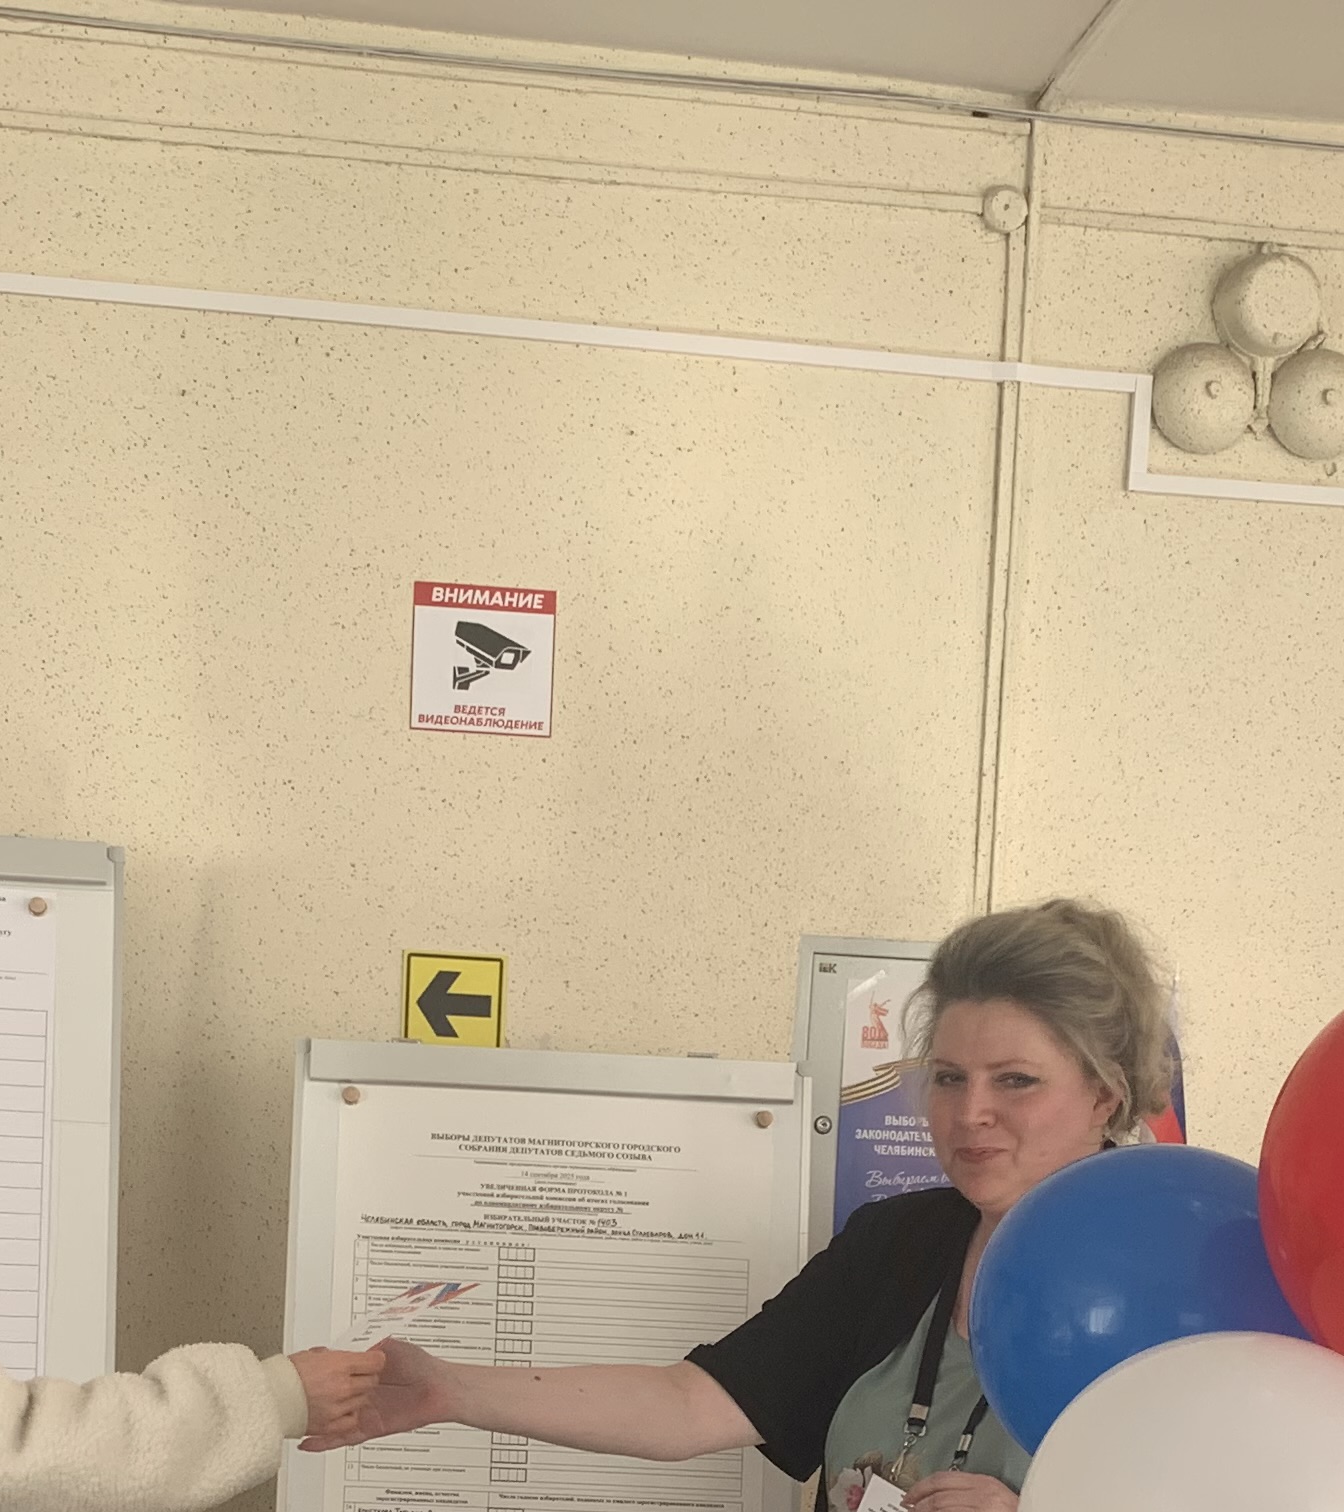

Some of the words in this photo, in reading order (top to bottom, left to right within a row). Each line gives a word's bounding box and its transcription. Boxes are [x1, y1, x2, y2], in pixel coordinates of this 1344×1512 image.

[431, 587, 545, 609] ВНИМАНИЕ
[453, 704, 506, 717] ВЕДЕТСЯ
[418, 714, 544, 731] ВИДЕОНАБЛЮДЕНИЕ
[855, 1128, 933, 1142] ЗАКОНОДАТЕЛЬ
[431, 1132, 471, 1142] ВЫБОРЫ
[471, 1134, 526, 1145] ДЕПУТАТОВ
[528, 1137, 620, 1150] МАГНИТОГОРСКОГО
[621, 1143, 681, 1154] ГОРОДСКОГО
[458, 1143, 507, 1153] СОБРАНИЯ
[509, 1146, 564, 1157] ДЕПУТАТОВ
[565, 1149, 614, 1160] СЕДЬМОГО
[616, 1152, 653, 1162] СОЗЫВА
[874, 1145, 936, 1157] ЧЕЛЯБИНСК
[538, 1186, 566, 1194] ФОРМА
